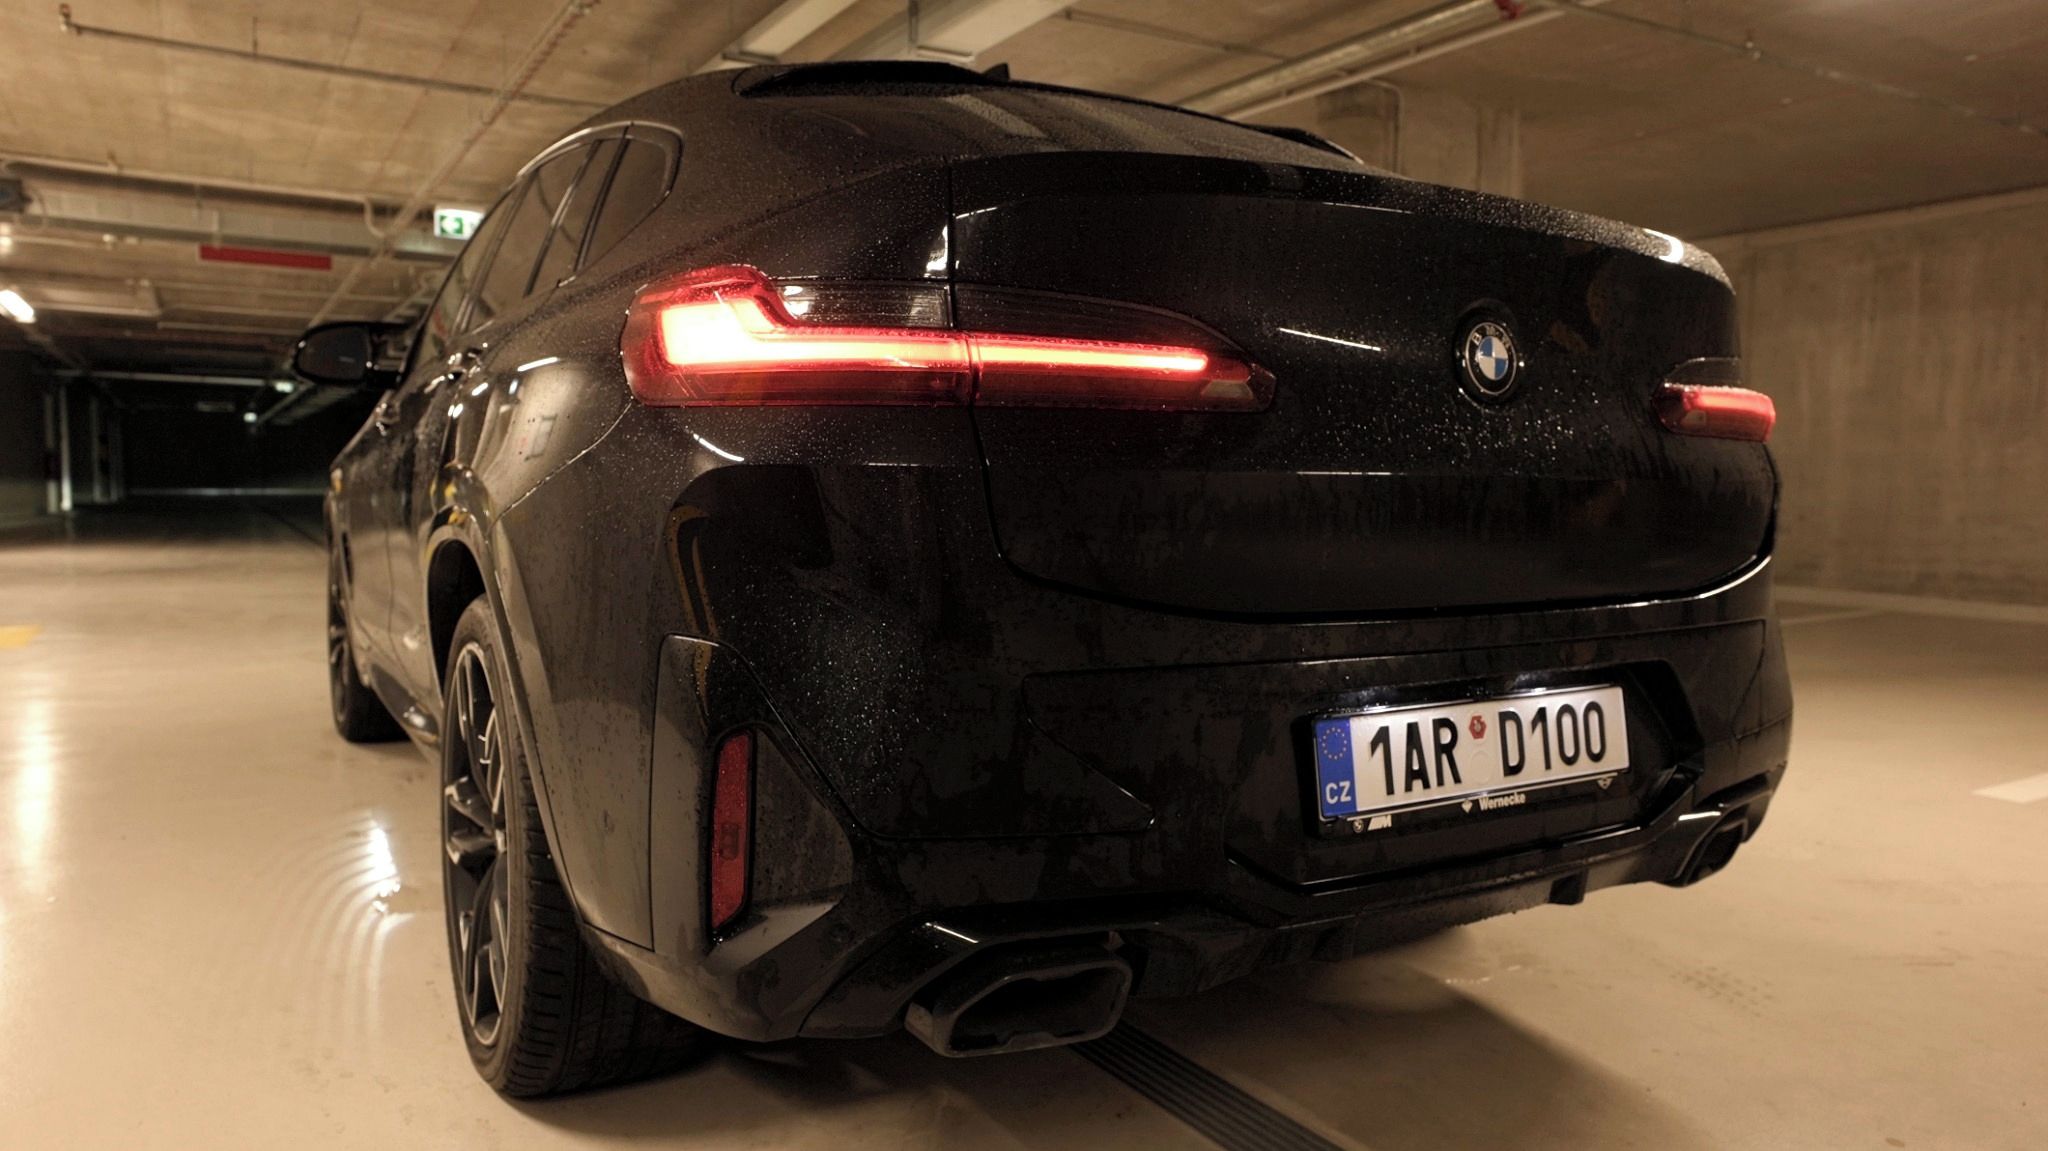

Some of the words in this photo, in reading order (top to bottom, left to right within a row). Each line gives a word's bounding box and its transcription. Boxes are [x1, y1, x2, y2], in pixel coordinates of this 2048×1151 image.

[1369, 717, 1462, 795] 1AR
[1498, 701, 1606, 777] D100
[1325, 781, 1351, 804] CZ
[1479, 792, 1526, 812] Wernecke
